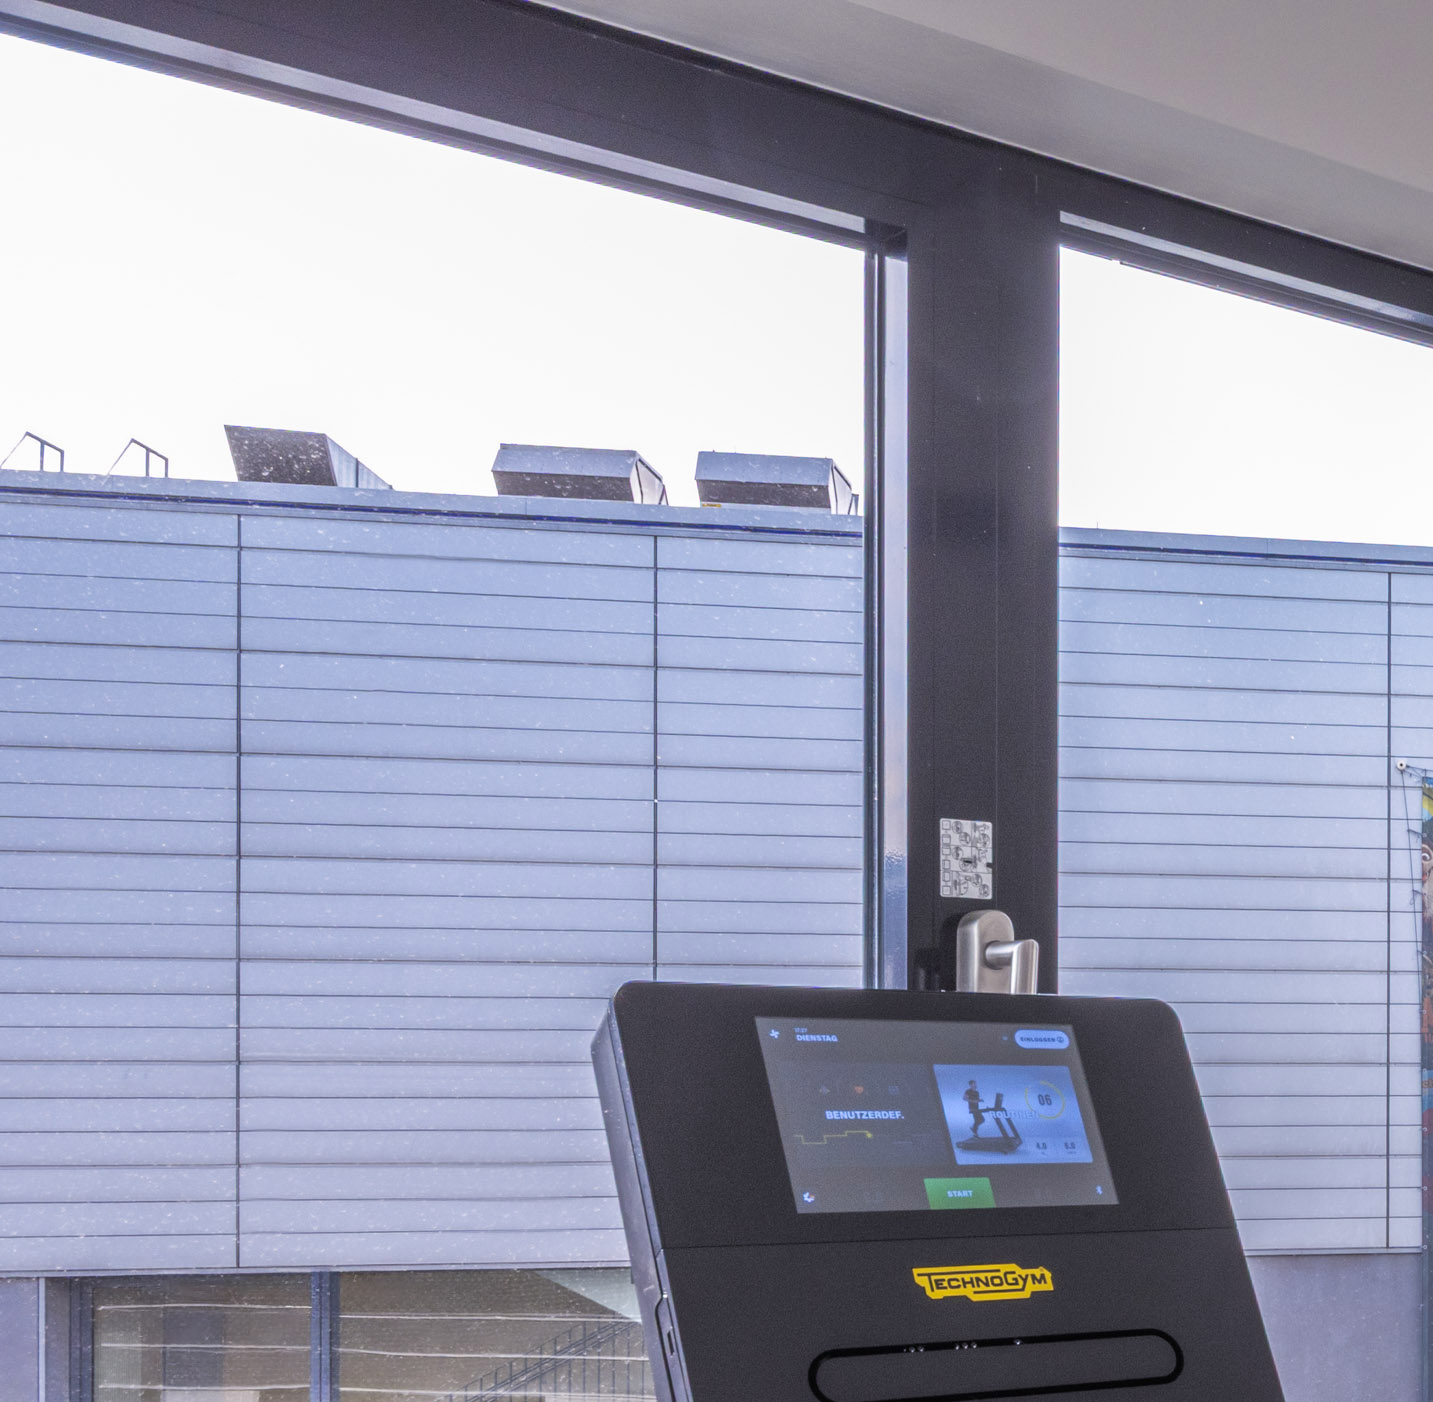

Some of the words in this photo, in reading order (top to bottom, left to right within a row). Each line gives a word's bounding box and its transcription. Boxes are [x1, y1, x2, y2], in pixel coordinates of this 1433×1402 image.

[796, 1034, 838, 1042] DIENSTAG
[1037, 1094, 1053, 1106] 06
[825, 1110, 905, 1120] BENUTZERDEF.
[947, 1190, 973, 1198] START
